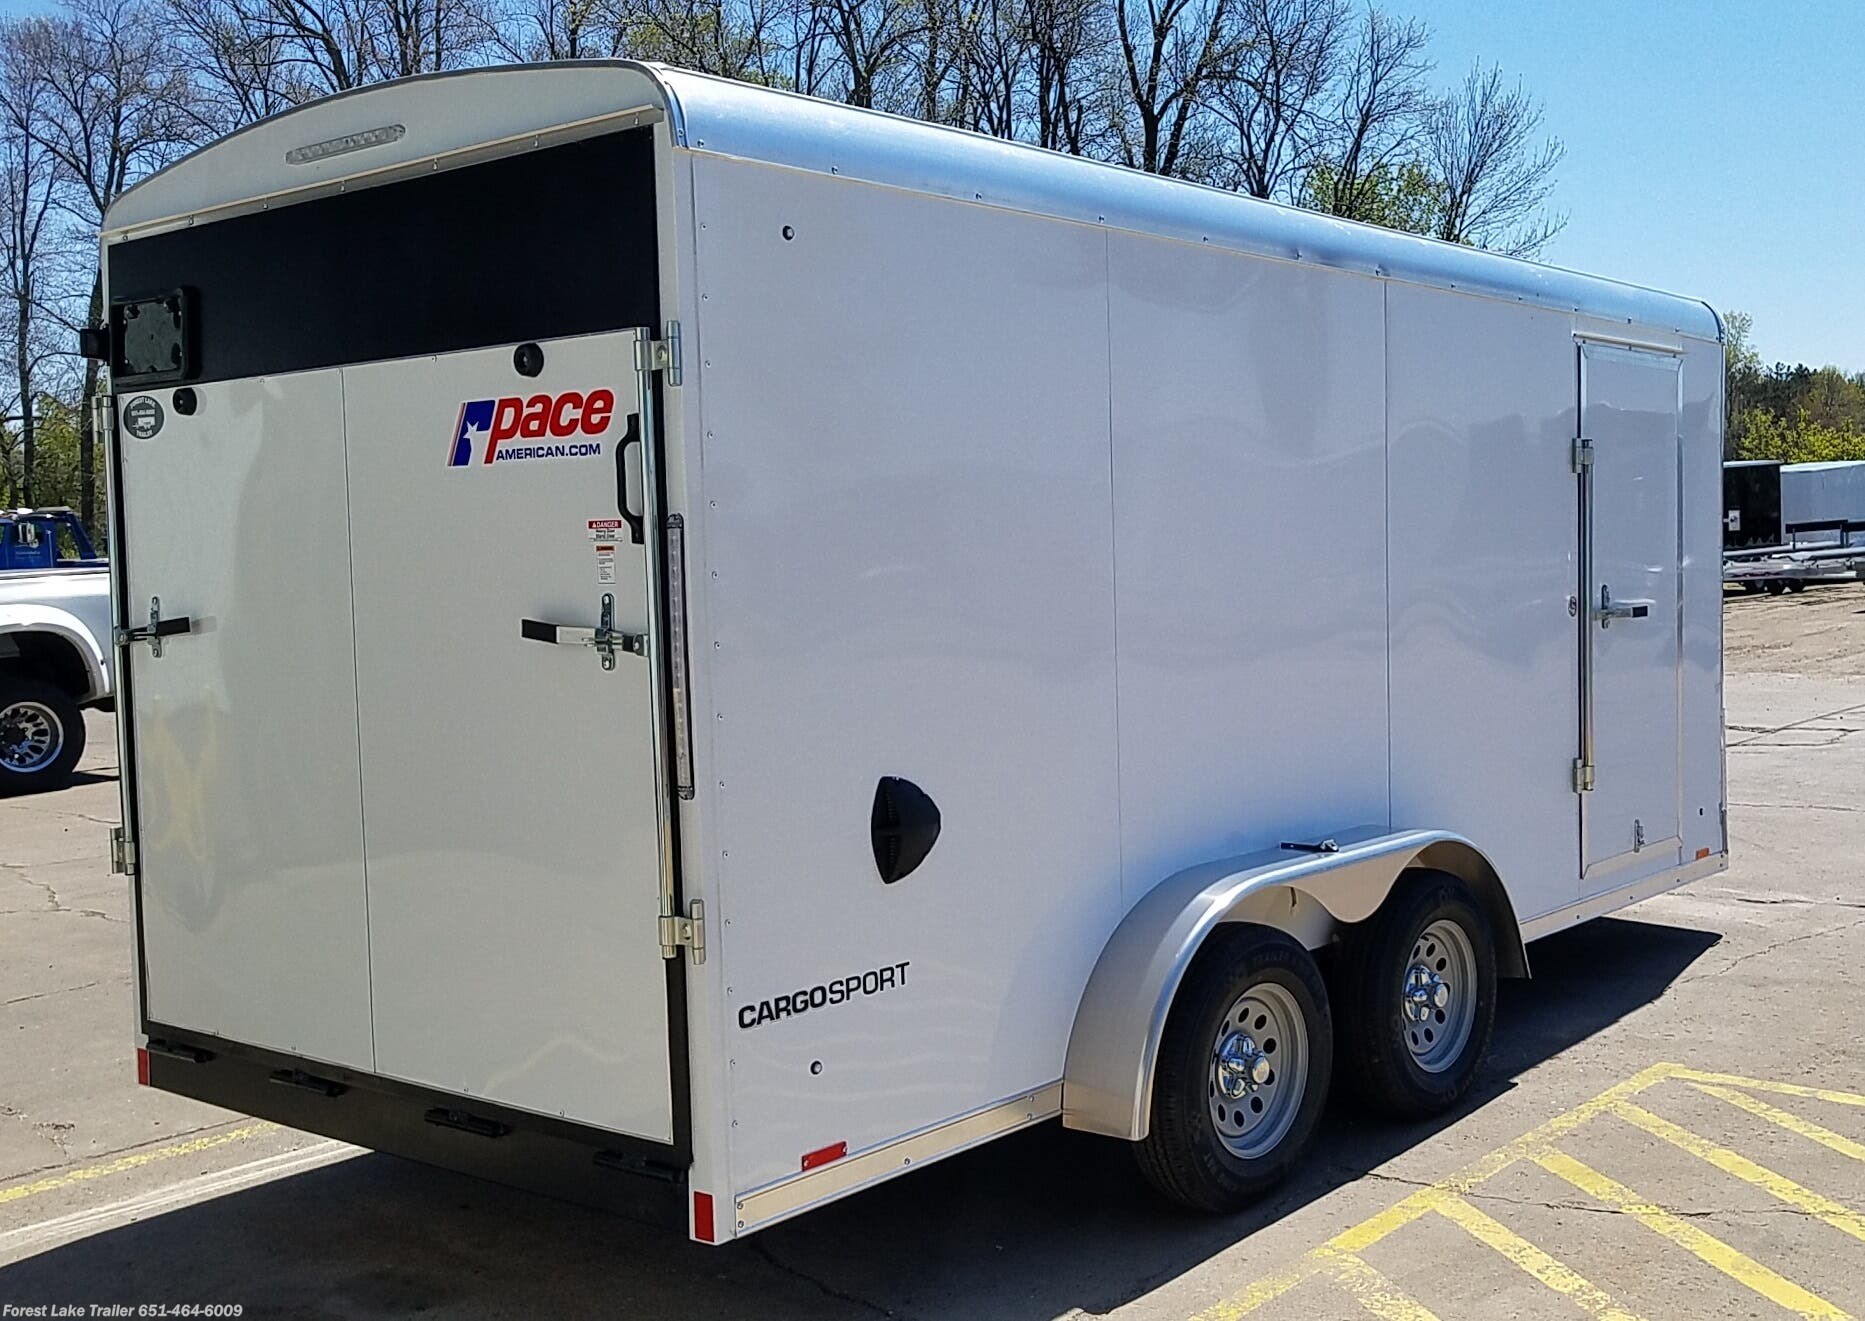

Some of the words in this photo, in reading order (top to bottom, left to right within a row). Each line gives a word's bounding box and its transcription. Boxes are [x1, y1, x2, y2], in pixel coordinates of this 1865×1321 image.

[484, 389, 614, 464] pace
[496, 443, 600, 461] AMERICAN.COM
[738, 961, 910, 1029] CARGOSPORT
